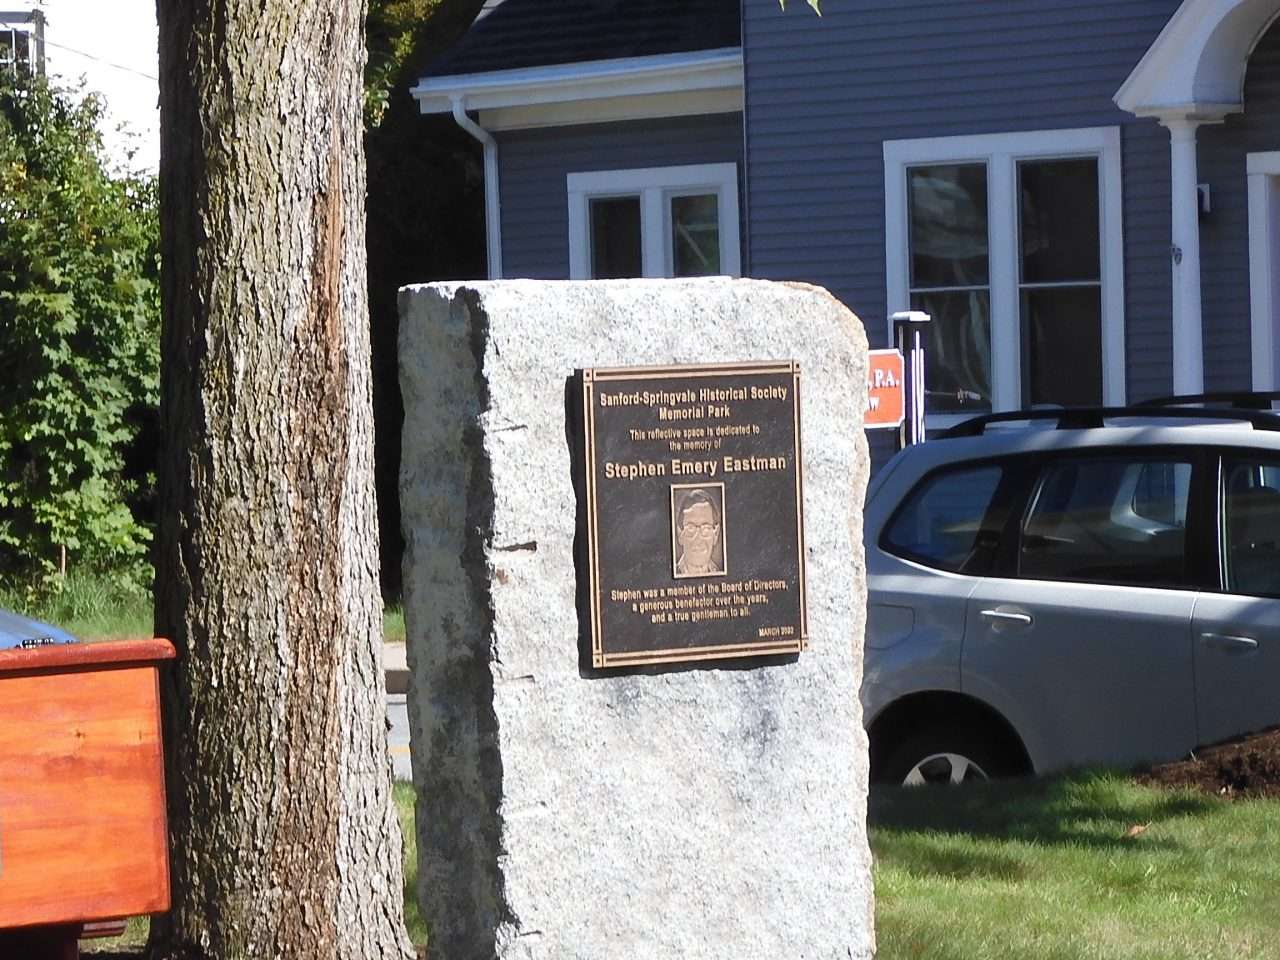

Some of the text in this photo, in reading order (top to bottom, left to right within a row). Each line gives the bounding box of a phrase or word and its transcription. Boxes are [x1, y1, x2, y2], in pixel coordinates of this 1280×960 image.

[874, 368, 900, 387] P.A.
[600, 385, 787, 407] Sanford-Springvale Historical Society
[659, 404, 730, 421] Memorial Park
[630, 424, 760, 440] This reflective space is dedicated to
[669, 438, 721, 451] the memory of
[605, 456, 786, 480] Stephen Emery Eastman
[611, 579, 788, 602] Stephen was a member of the Board of Directors,
[632, 593, 768, 614] a generous benefactor over the years,
[651, 606, 751, 623] and a true gentleman to all.
[758, 626, 780, 637] MARCH
